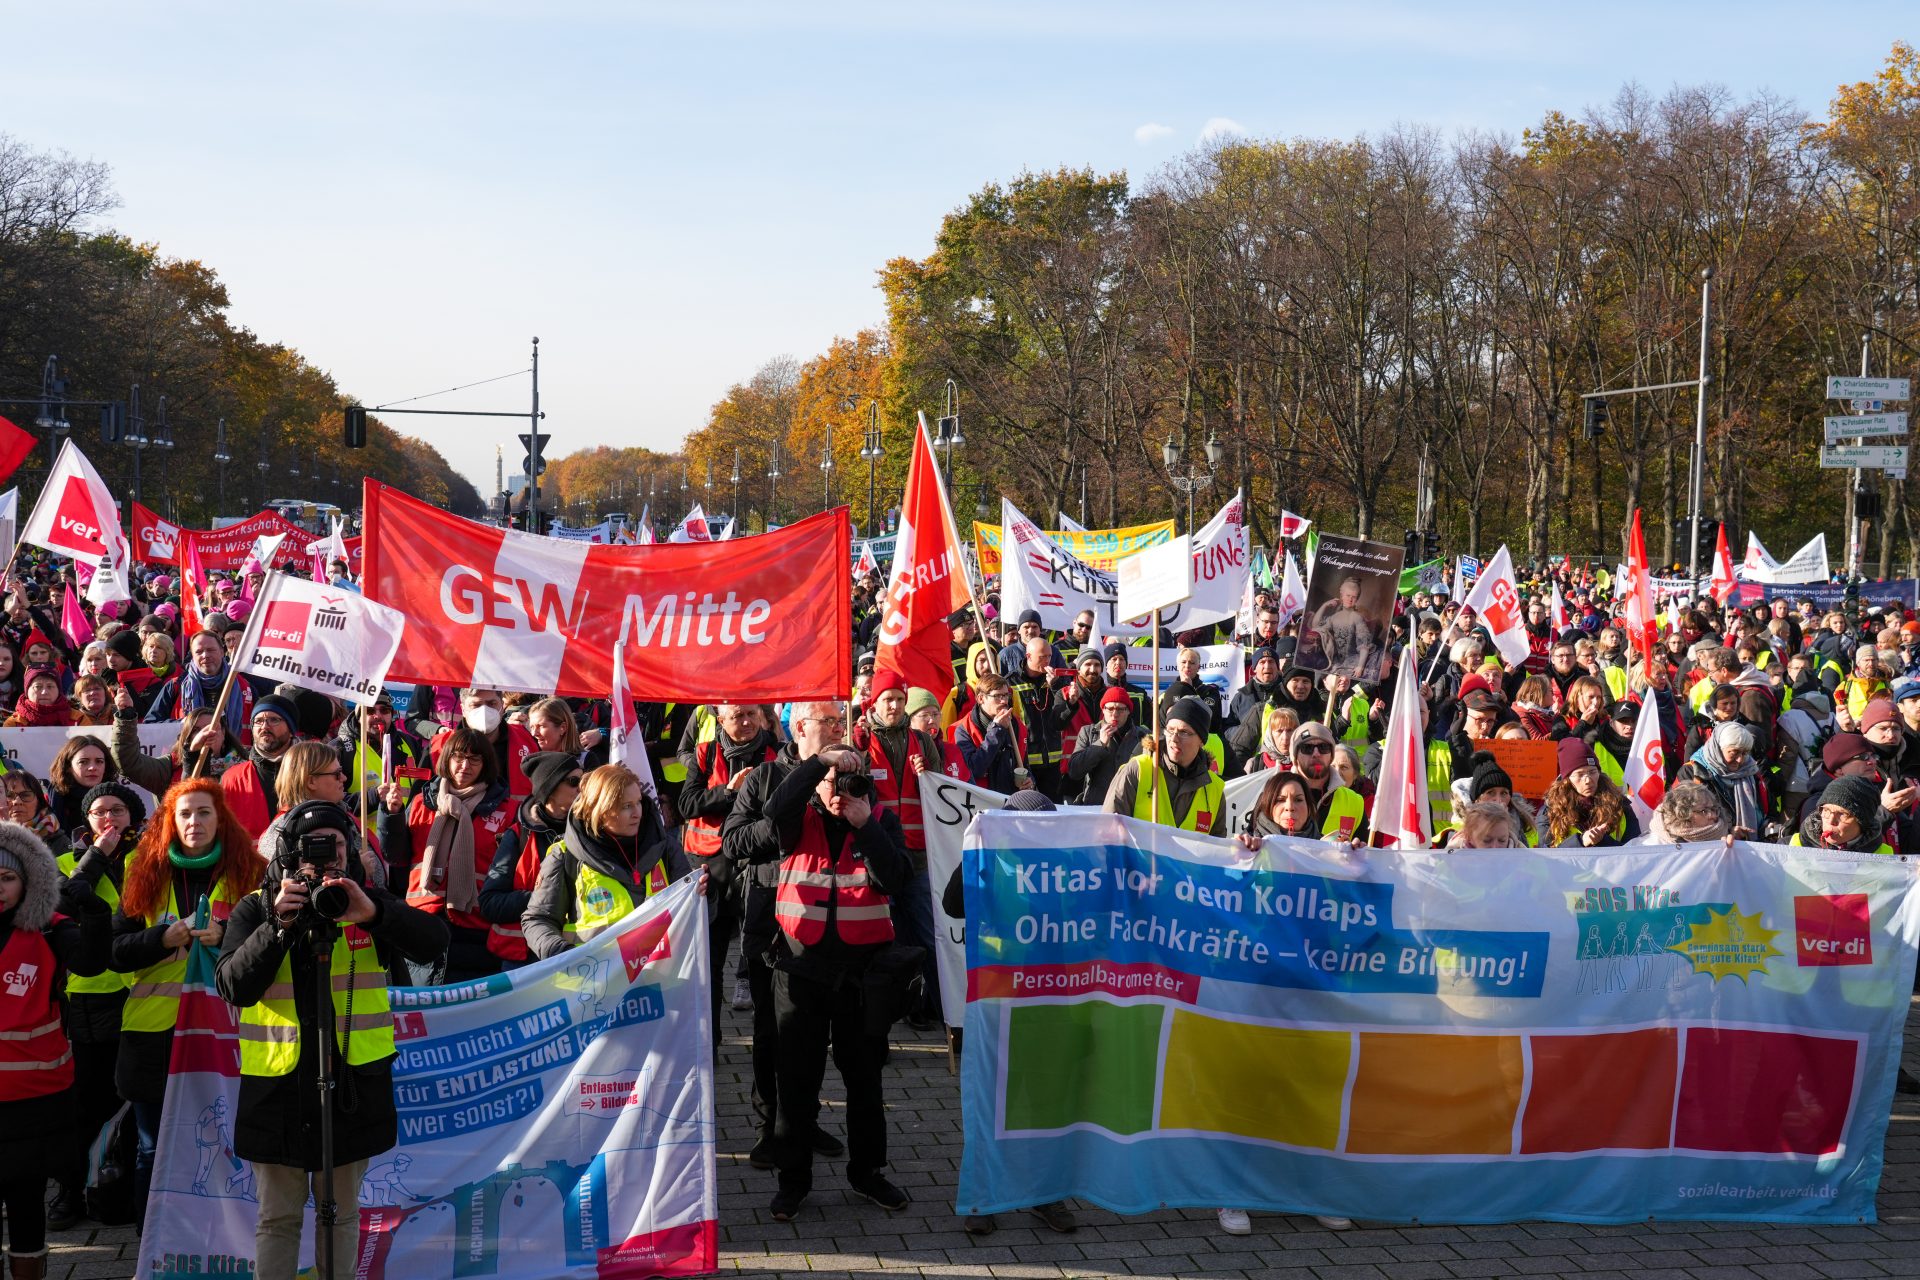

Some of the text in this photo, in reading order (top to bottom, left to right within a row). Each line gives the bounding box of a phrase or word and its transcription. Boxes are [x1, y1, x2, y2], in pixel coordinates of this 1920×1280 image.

[1843, 380, 1890, 389] Charlottenburg
[1843, 389, 1875, 397] Tiergarten
[1825, 458, 1857, 466] Reichstag
[201, 517, 280, 539] Gewerkschaft
[198, 542, 221, 553] und
[1321, 542, 1345, 554] Dann
[1320, 555, 1354, 569] Wohngeld
[1771, 588, 1829, 597] Betriebsgruppe
[440, 563, 772, 648] GEW Mitte
[264, 627, 303, 644] ver.di
[251, 649, 377, 697] berlin.verdi.de
[1015, 863, 1378, 932] Kitas vor dem Kollaps
[1014, 913, 1098, 944] Ohne
[1110, 910, 1270, 964] Fachkräfte
[1303, 939, 1386, 974] keine
[1398, 945, 1528, 986] Bildung!
[1687, 943, 1766, 953] Gemeinsam stark
[1801, 936, 1866, 955] ver.di
[1696, 952, 1762, 965] für gute Kitas!
[2, 970, 37, 988] GEW
[1012, 964, 1185, 993] Personalbarometer
[393, 1006, 566, 1071] Wenn nicht WIR
[396, 1083, 432, 1105] für
[436, 1036, 573, 1099] ENTLASTUNG
[580, 1079, 637, 1095] Entlastung
[600, 1094, 639, 1110] Bildung
[402, 1086, 537, 1139] wer sonst?!
[1678, 1182, 1839, 1200] sozialearbeit.verdi.de
[580, 1173, 594, 1250] TARIFPOLITIK
[470, 1188, 485, 1263] FACHPOLITIK
